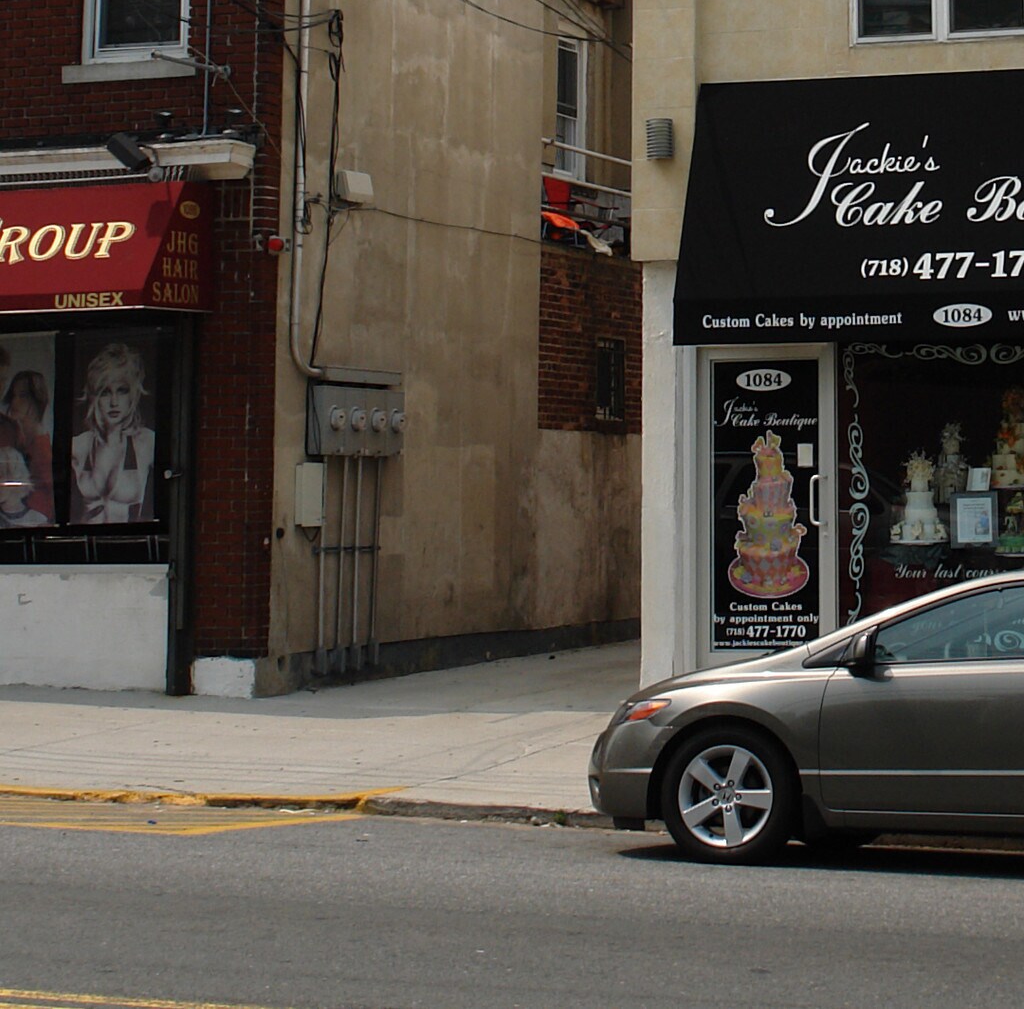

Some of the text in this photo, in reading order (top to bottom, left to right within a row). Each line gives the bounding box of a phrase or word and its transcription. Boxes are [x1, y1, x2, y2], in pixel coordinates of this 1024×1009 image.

[764, 122, 940, 227] Jackie's
[831, 180, 943, 227] Cake
[0, 218, 136, 265] ROUP
[166, 230, 199, 255] JHG
[162, 257, 199, 279] HAIR
[861, 257, 909, 278] (718)
[55, 292, 124, 309] UNISEX
[152, 281, 199, 304] SALON
[702, 311, 903, 329] Custom Cakes by appointment
[942, 307, 984, 323] 1084
[744, 373, 783, 387] 1084
[731, 412, 818, 431] Cake Boutique
[894, 563, 927, 579] Your
[934, 563, 962, 578] last
[729, 601, 803, 611] Custom Cakes
[713, 613, 820, 624] by appointment only
[746, 625, 806, 638] 477-1770
